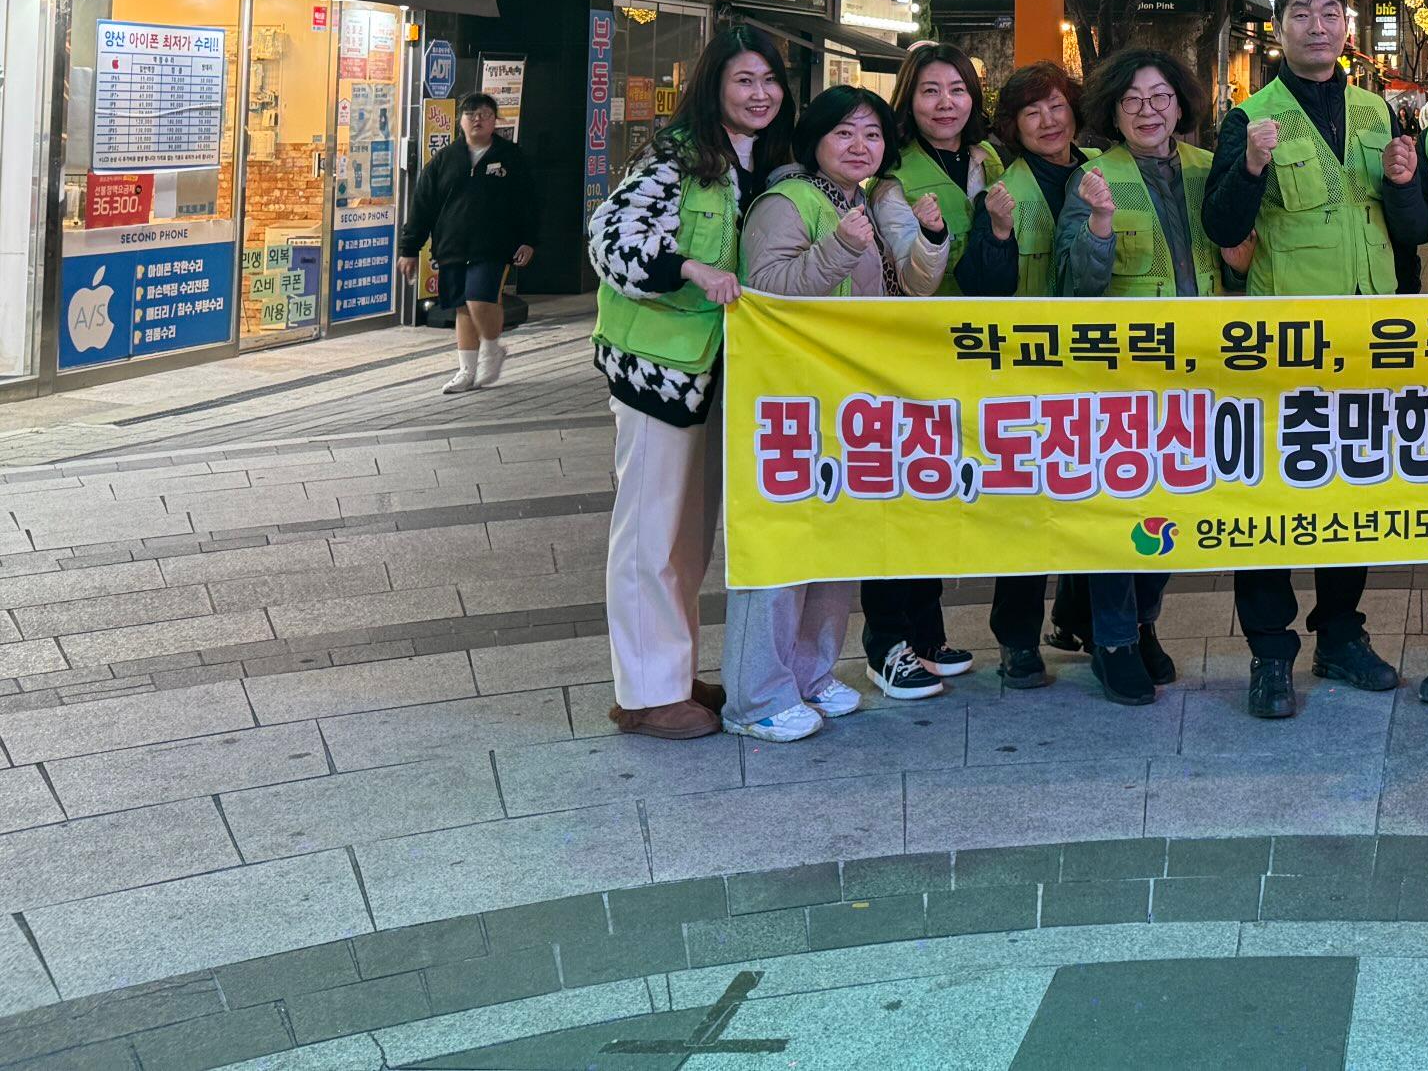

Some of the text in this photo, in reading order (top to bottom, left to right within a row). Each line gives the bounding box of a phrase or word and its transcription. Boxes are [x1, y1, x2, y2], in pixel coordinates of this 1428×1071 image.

[1156, 1, 1175, 10] Pink
[1375, 1, 1397, 15] bhc
[104, 30, 219, 53] 양산 아이폰 최저가 수리!!
[429, 60, 451, 79] ADT
[588, 13, 611, 150] 부동산
[93, 196, 139, 217] 36,300
[340, 211, 389, 223] SECOND PHONE
[120, 228, 189, 244] SECOND PHONE
[268, 248, 290, 265] 회복
[147, 259, 203, 278] 아이폰 착한수리
[179, 278, 210, 294] 수리전문
[253, 274, 302, 294] 소비 쿠폰
[74, 303, 106, 330] A/S
[263, 301, 313, 321] 사용 가능
[950, 322, 1197, 373] 학교폭력,
[1220, 319, 1346, 374] 왕따,
